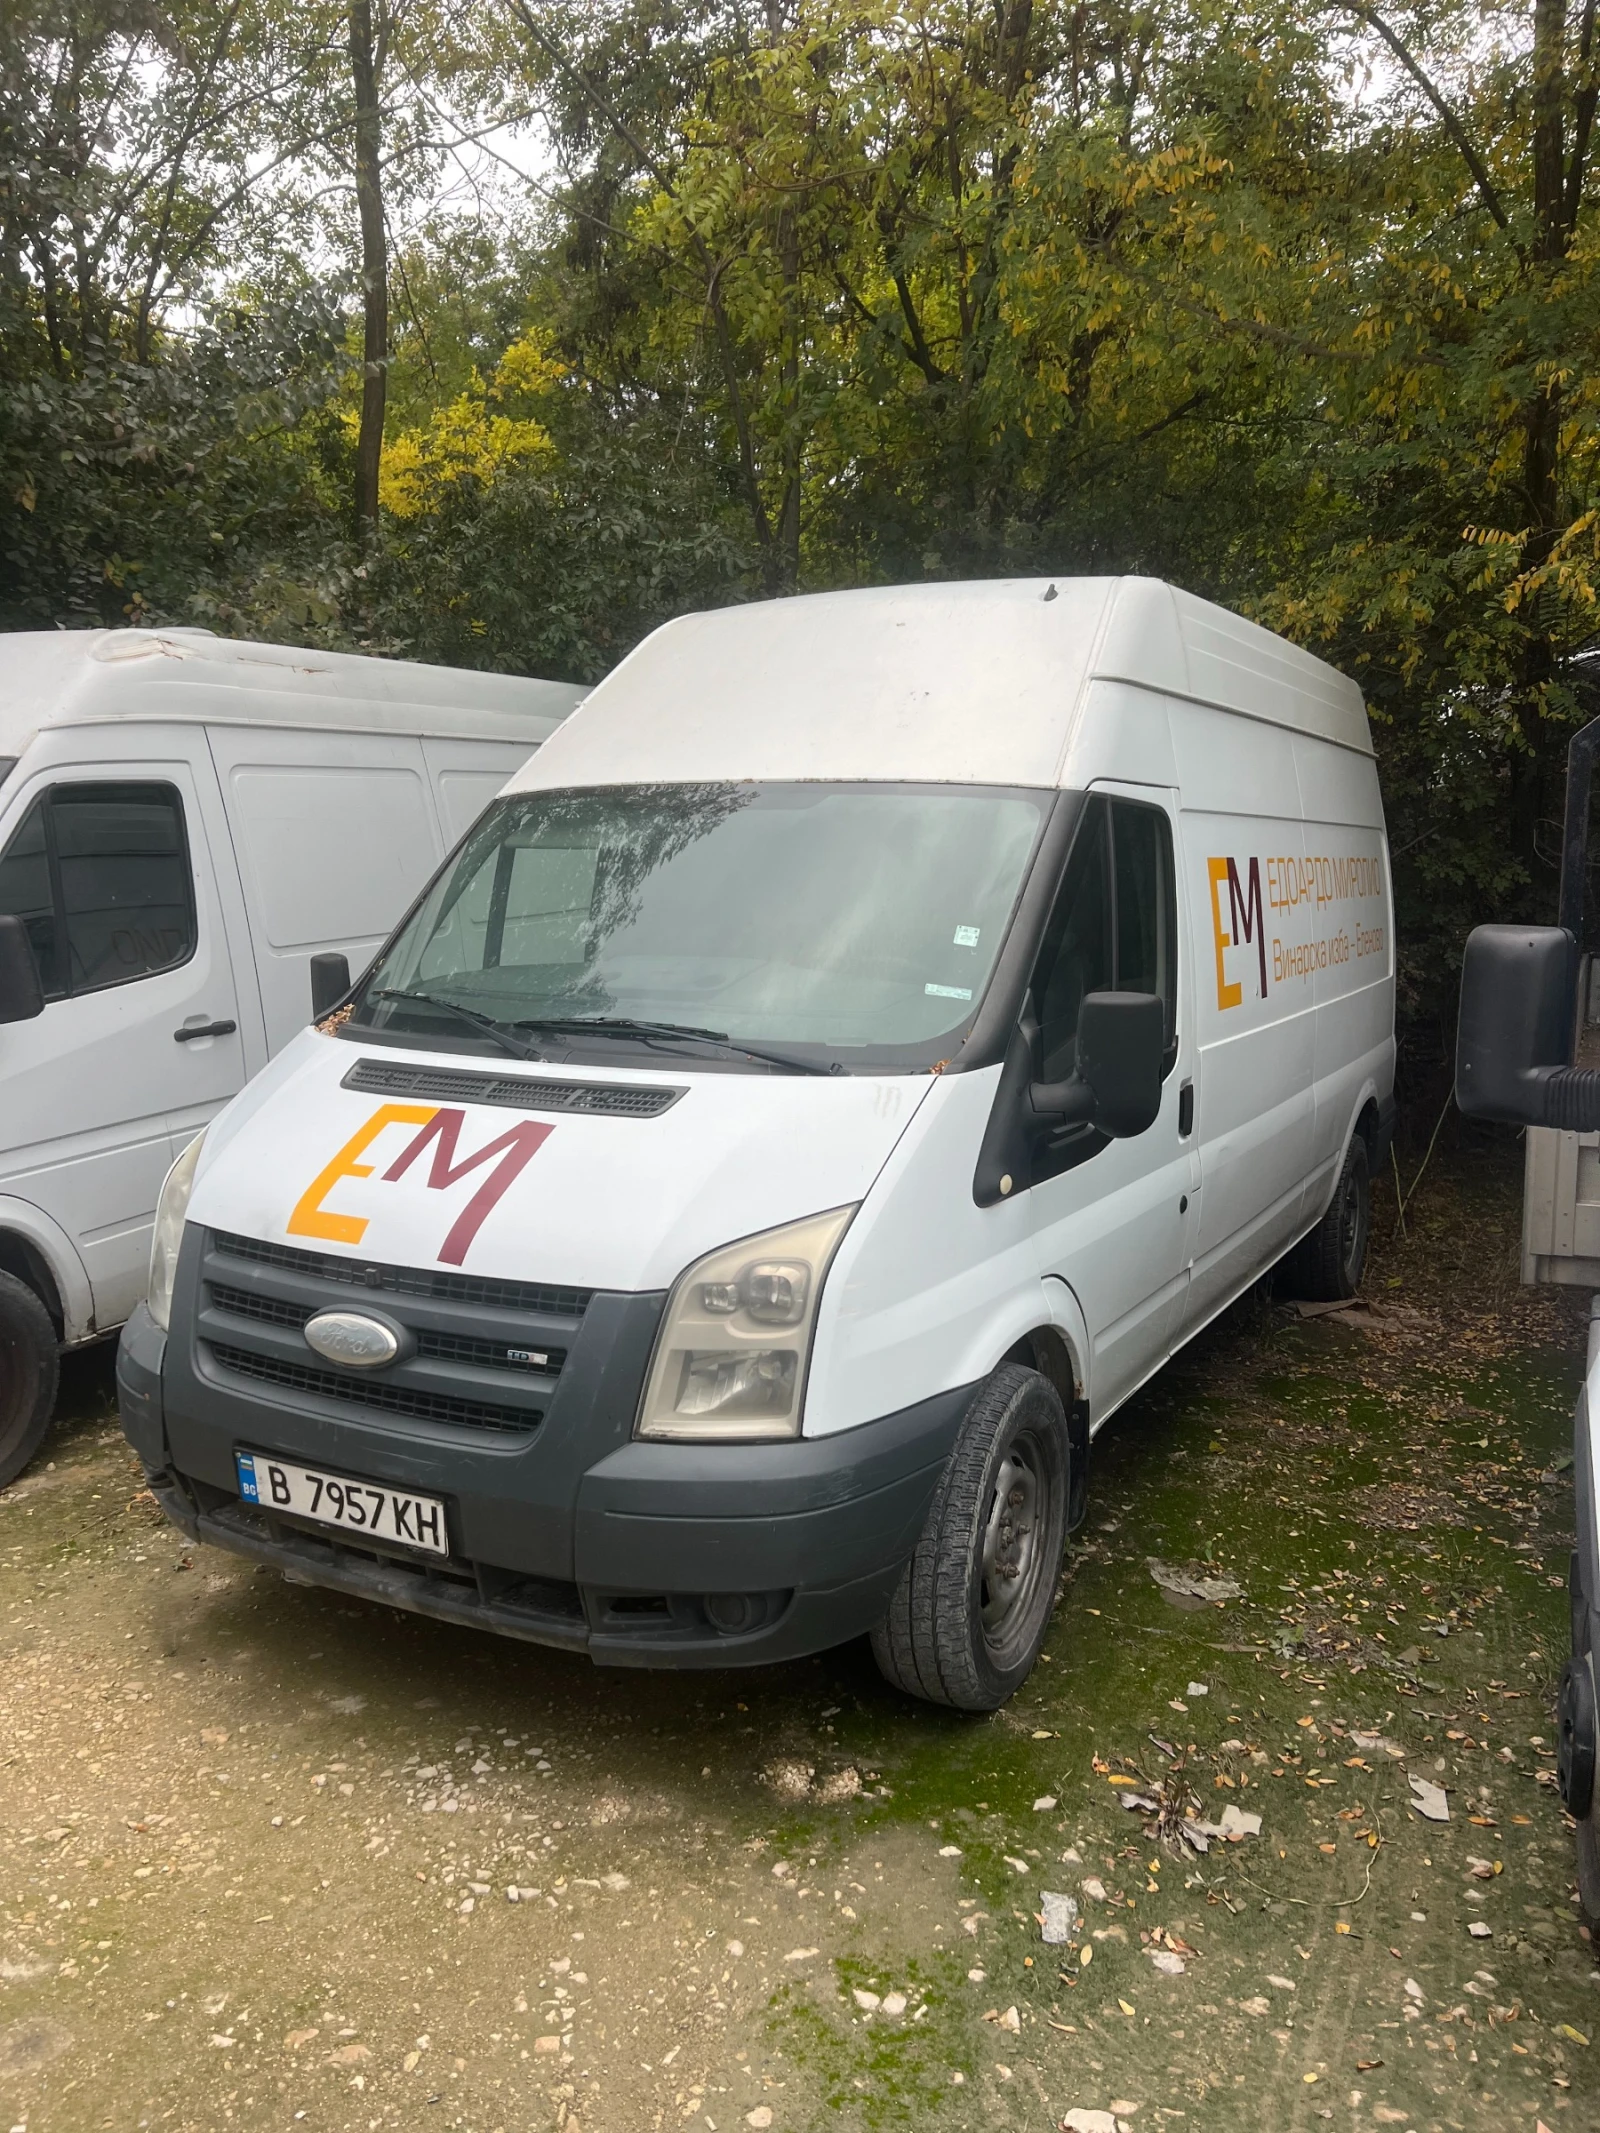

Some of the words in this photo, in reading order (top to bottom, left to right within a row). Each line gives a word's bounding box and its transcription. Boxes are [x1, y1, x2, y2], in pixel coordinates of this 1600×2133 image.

[1266, 856, 1333, 918] ЕДОАРДО
[1272, 938, 1327, 985] Винарска
[1328, 928, 1349, 966] изба
[320, 1321, 372, 1355] Ford
[243, 1482, 257, 1497] BG
[268, 1465, 291, 1505] B
